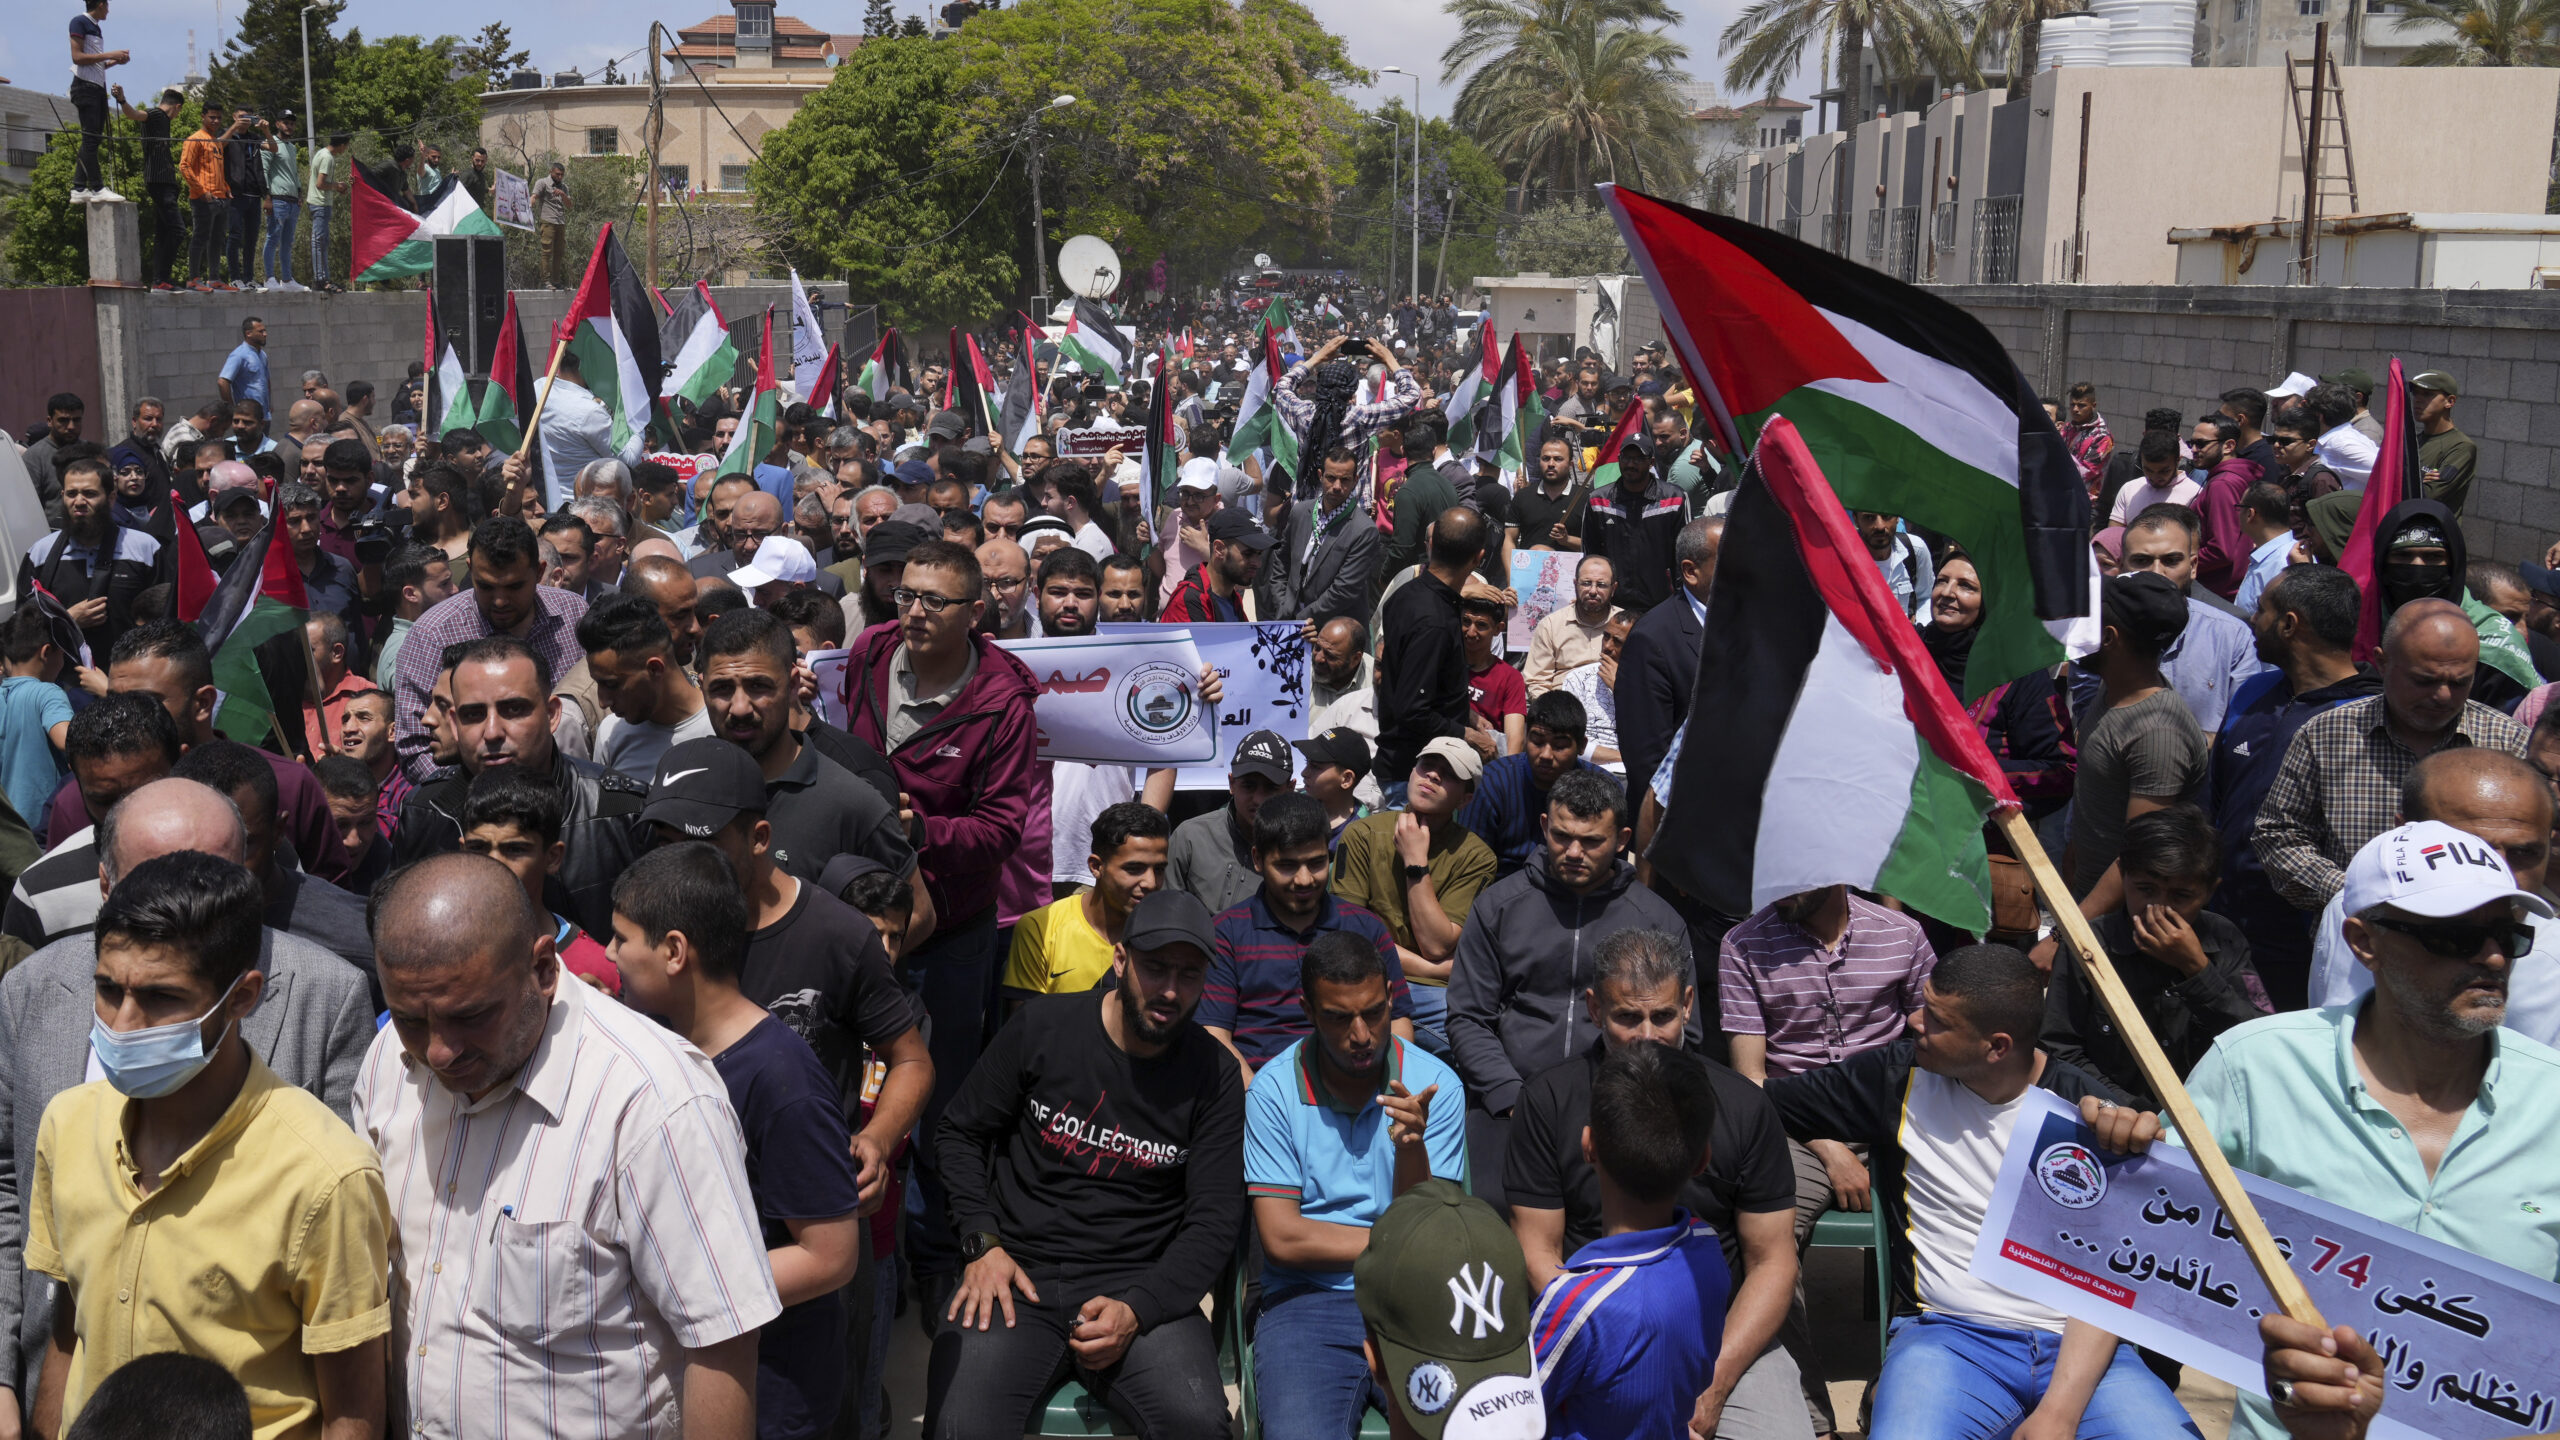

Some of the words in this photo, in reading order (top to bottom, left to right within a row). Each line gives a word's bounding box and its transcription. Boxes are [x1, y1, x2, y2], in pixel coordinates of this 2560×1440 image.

[1248, 750, 1273, 760] adidas
[685, 823, 712, 837] NIKE
[2420, 842, 2502, 871] FILA
[1052, 1112, 1177, 1165] COLLECTIONS
[2141, 1187, 2201, 1227] من
[2007, 1243, 2058, 1272] الفلسطينية
[2059, 1266, 2091, 1285] العربية
[2107, 1237, 2241, 1309] عائدون
[2310, 1235, 2372, 1289] 74
[1447, 1261, 1505, 1339] NY
[2092, 1278, 2126, 1299] الجبهة
[2374, 1279, 2490, 1339] كفى
[1468, 1389, 1538, 1422] NEWYORK
[2430, 1372, 2555, 1433] الظلم
